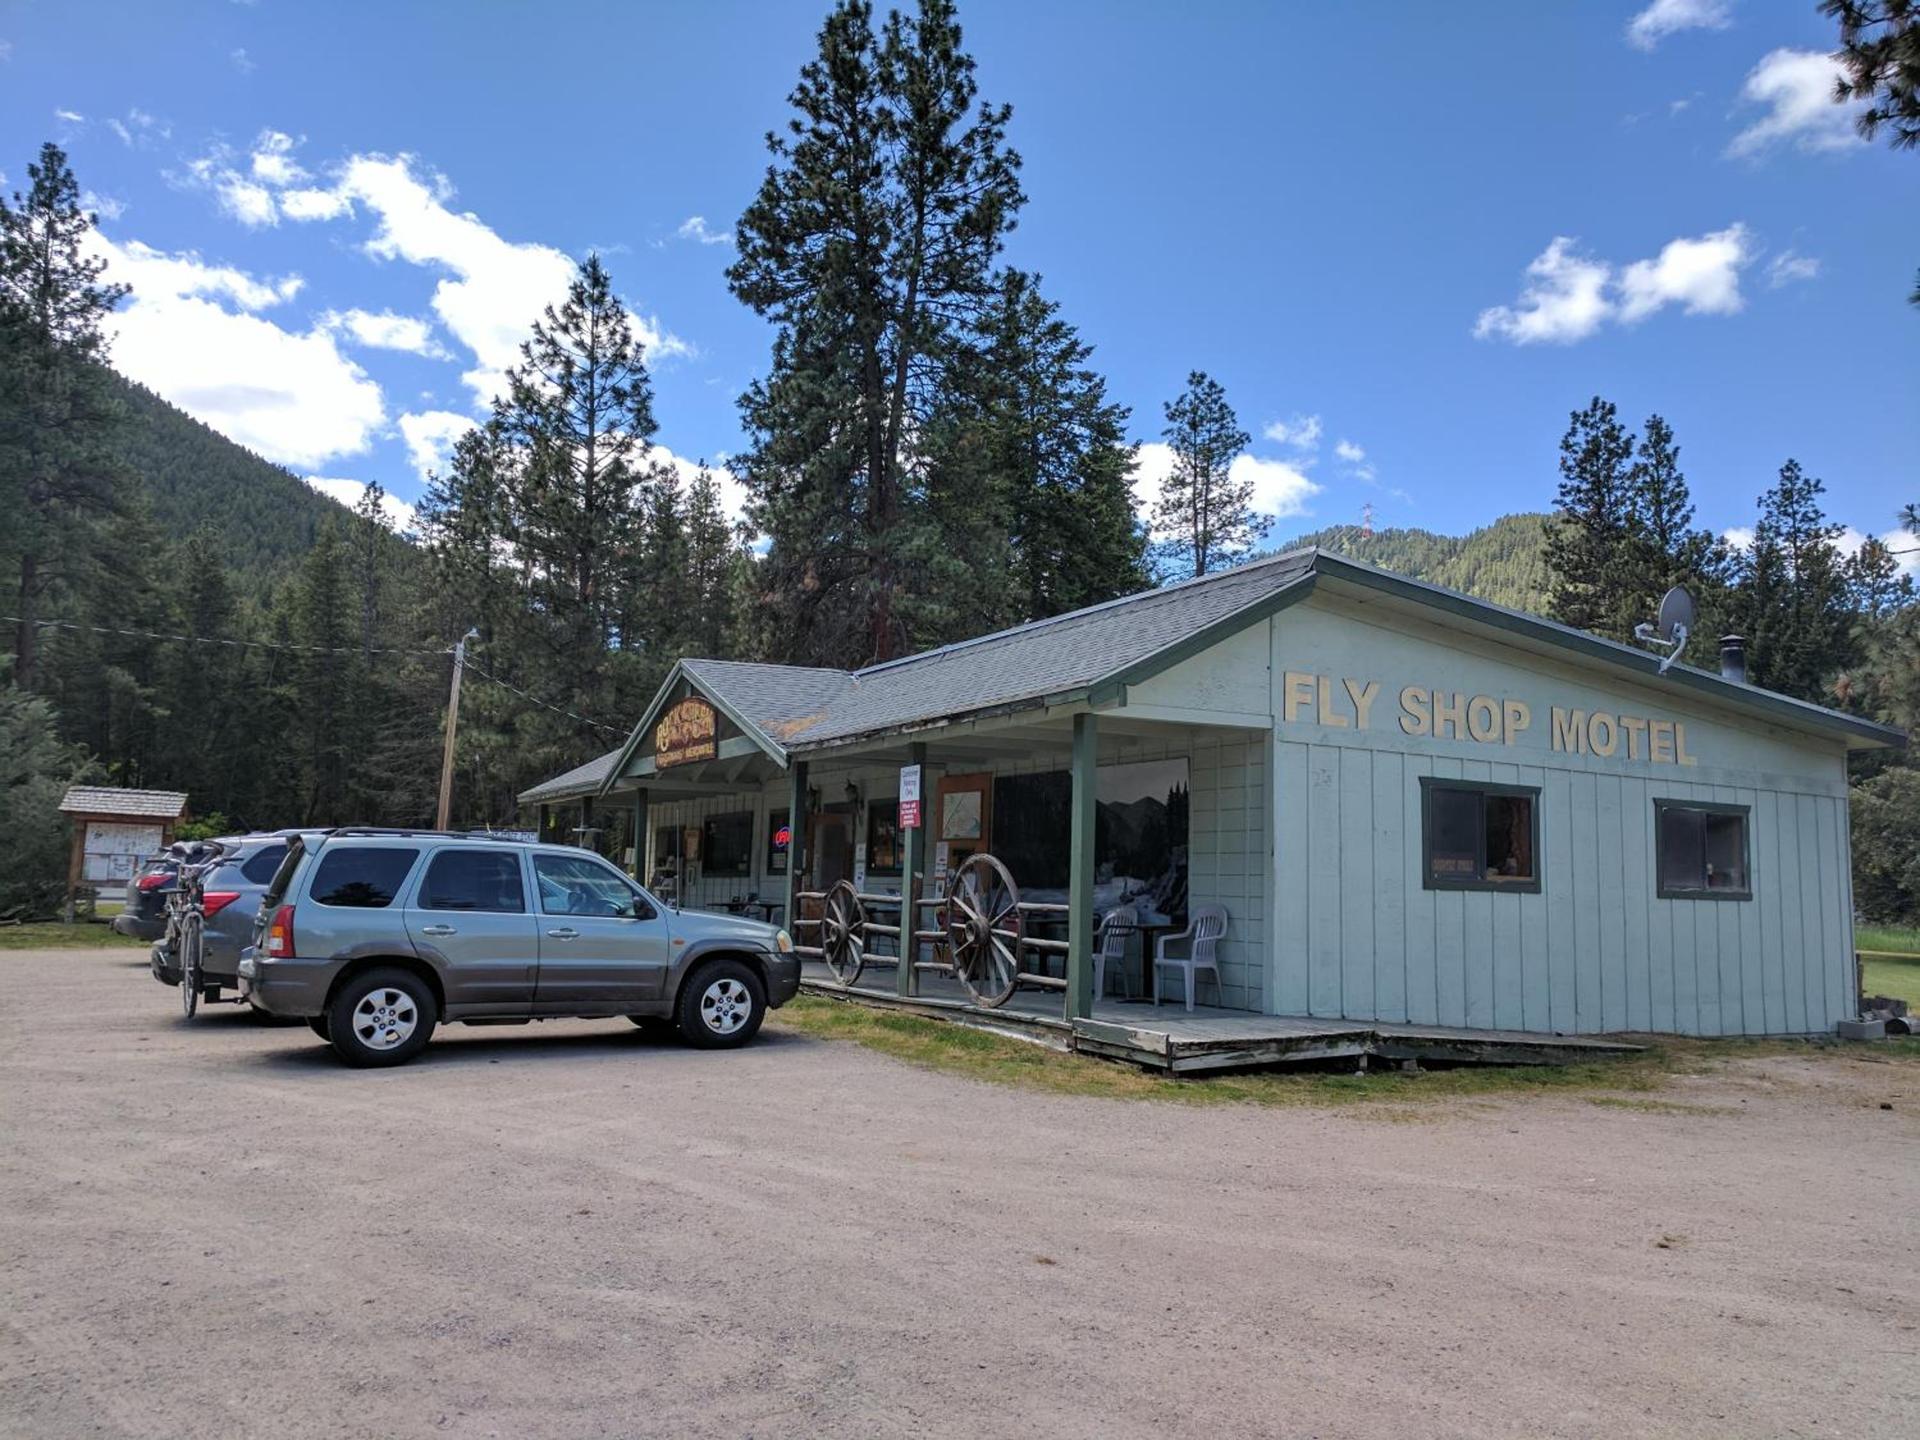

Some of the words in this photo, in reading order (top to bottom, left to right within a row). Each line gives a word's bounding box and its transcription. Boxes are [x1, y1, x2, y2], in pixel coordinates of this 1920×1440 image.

[1283, 671, 1380, 730] FLY
[1399, 686, 1531, 746] SHOP
[1551, 705, 1697, 766] MOTEL
